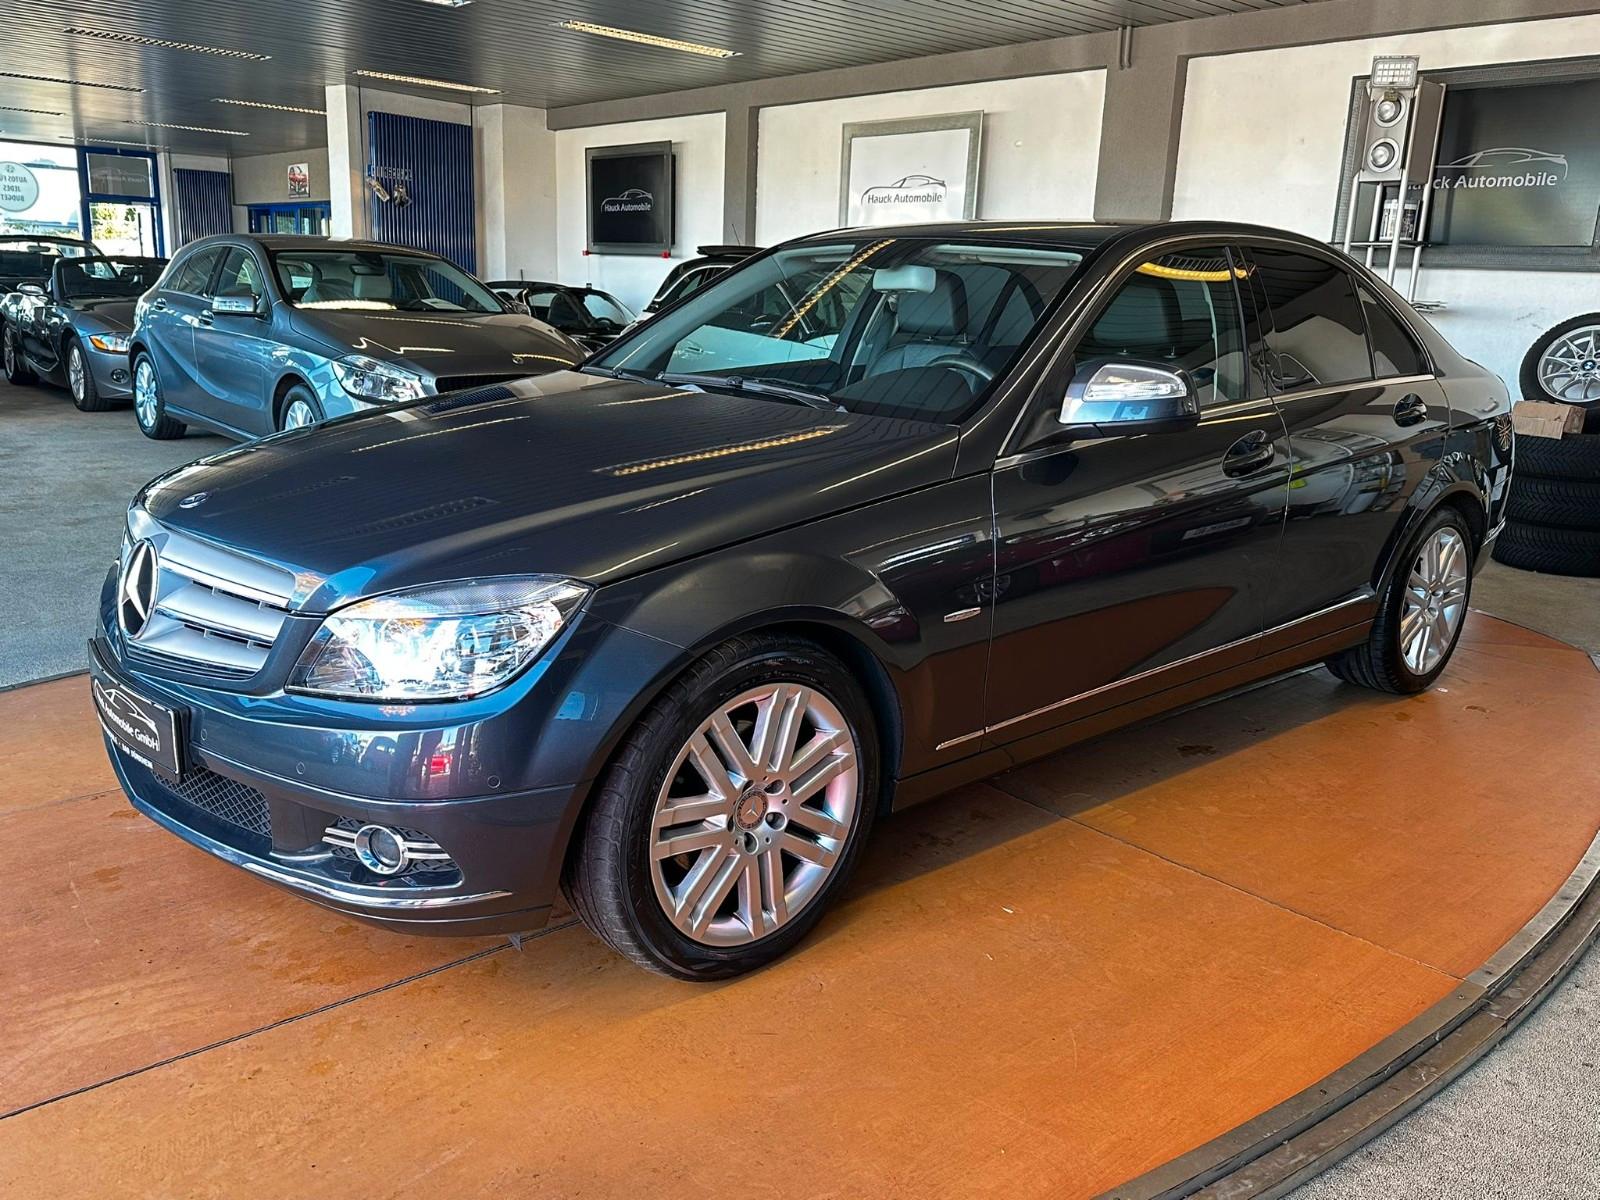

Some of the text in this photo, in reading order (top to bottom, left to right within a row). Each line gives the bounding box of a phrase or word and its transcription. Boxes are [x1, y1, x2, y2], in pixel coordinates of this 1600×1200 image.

[1453, 171, 1558, 189] Automobile
[868, 193, 942, 203] Hauck Automobile
[604, 202, 651, 212] Hauck Automobile
[135, 728, 158, 751] GmbH
